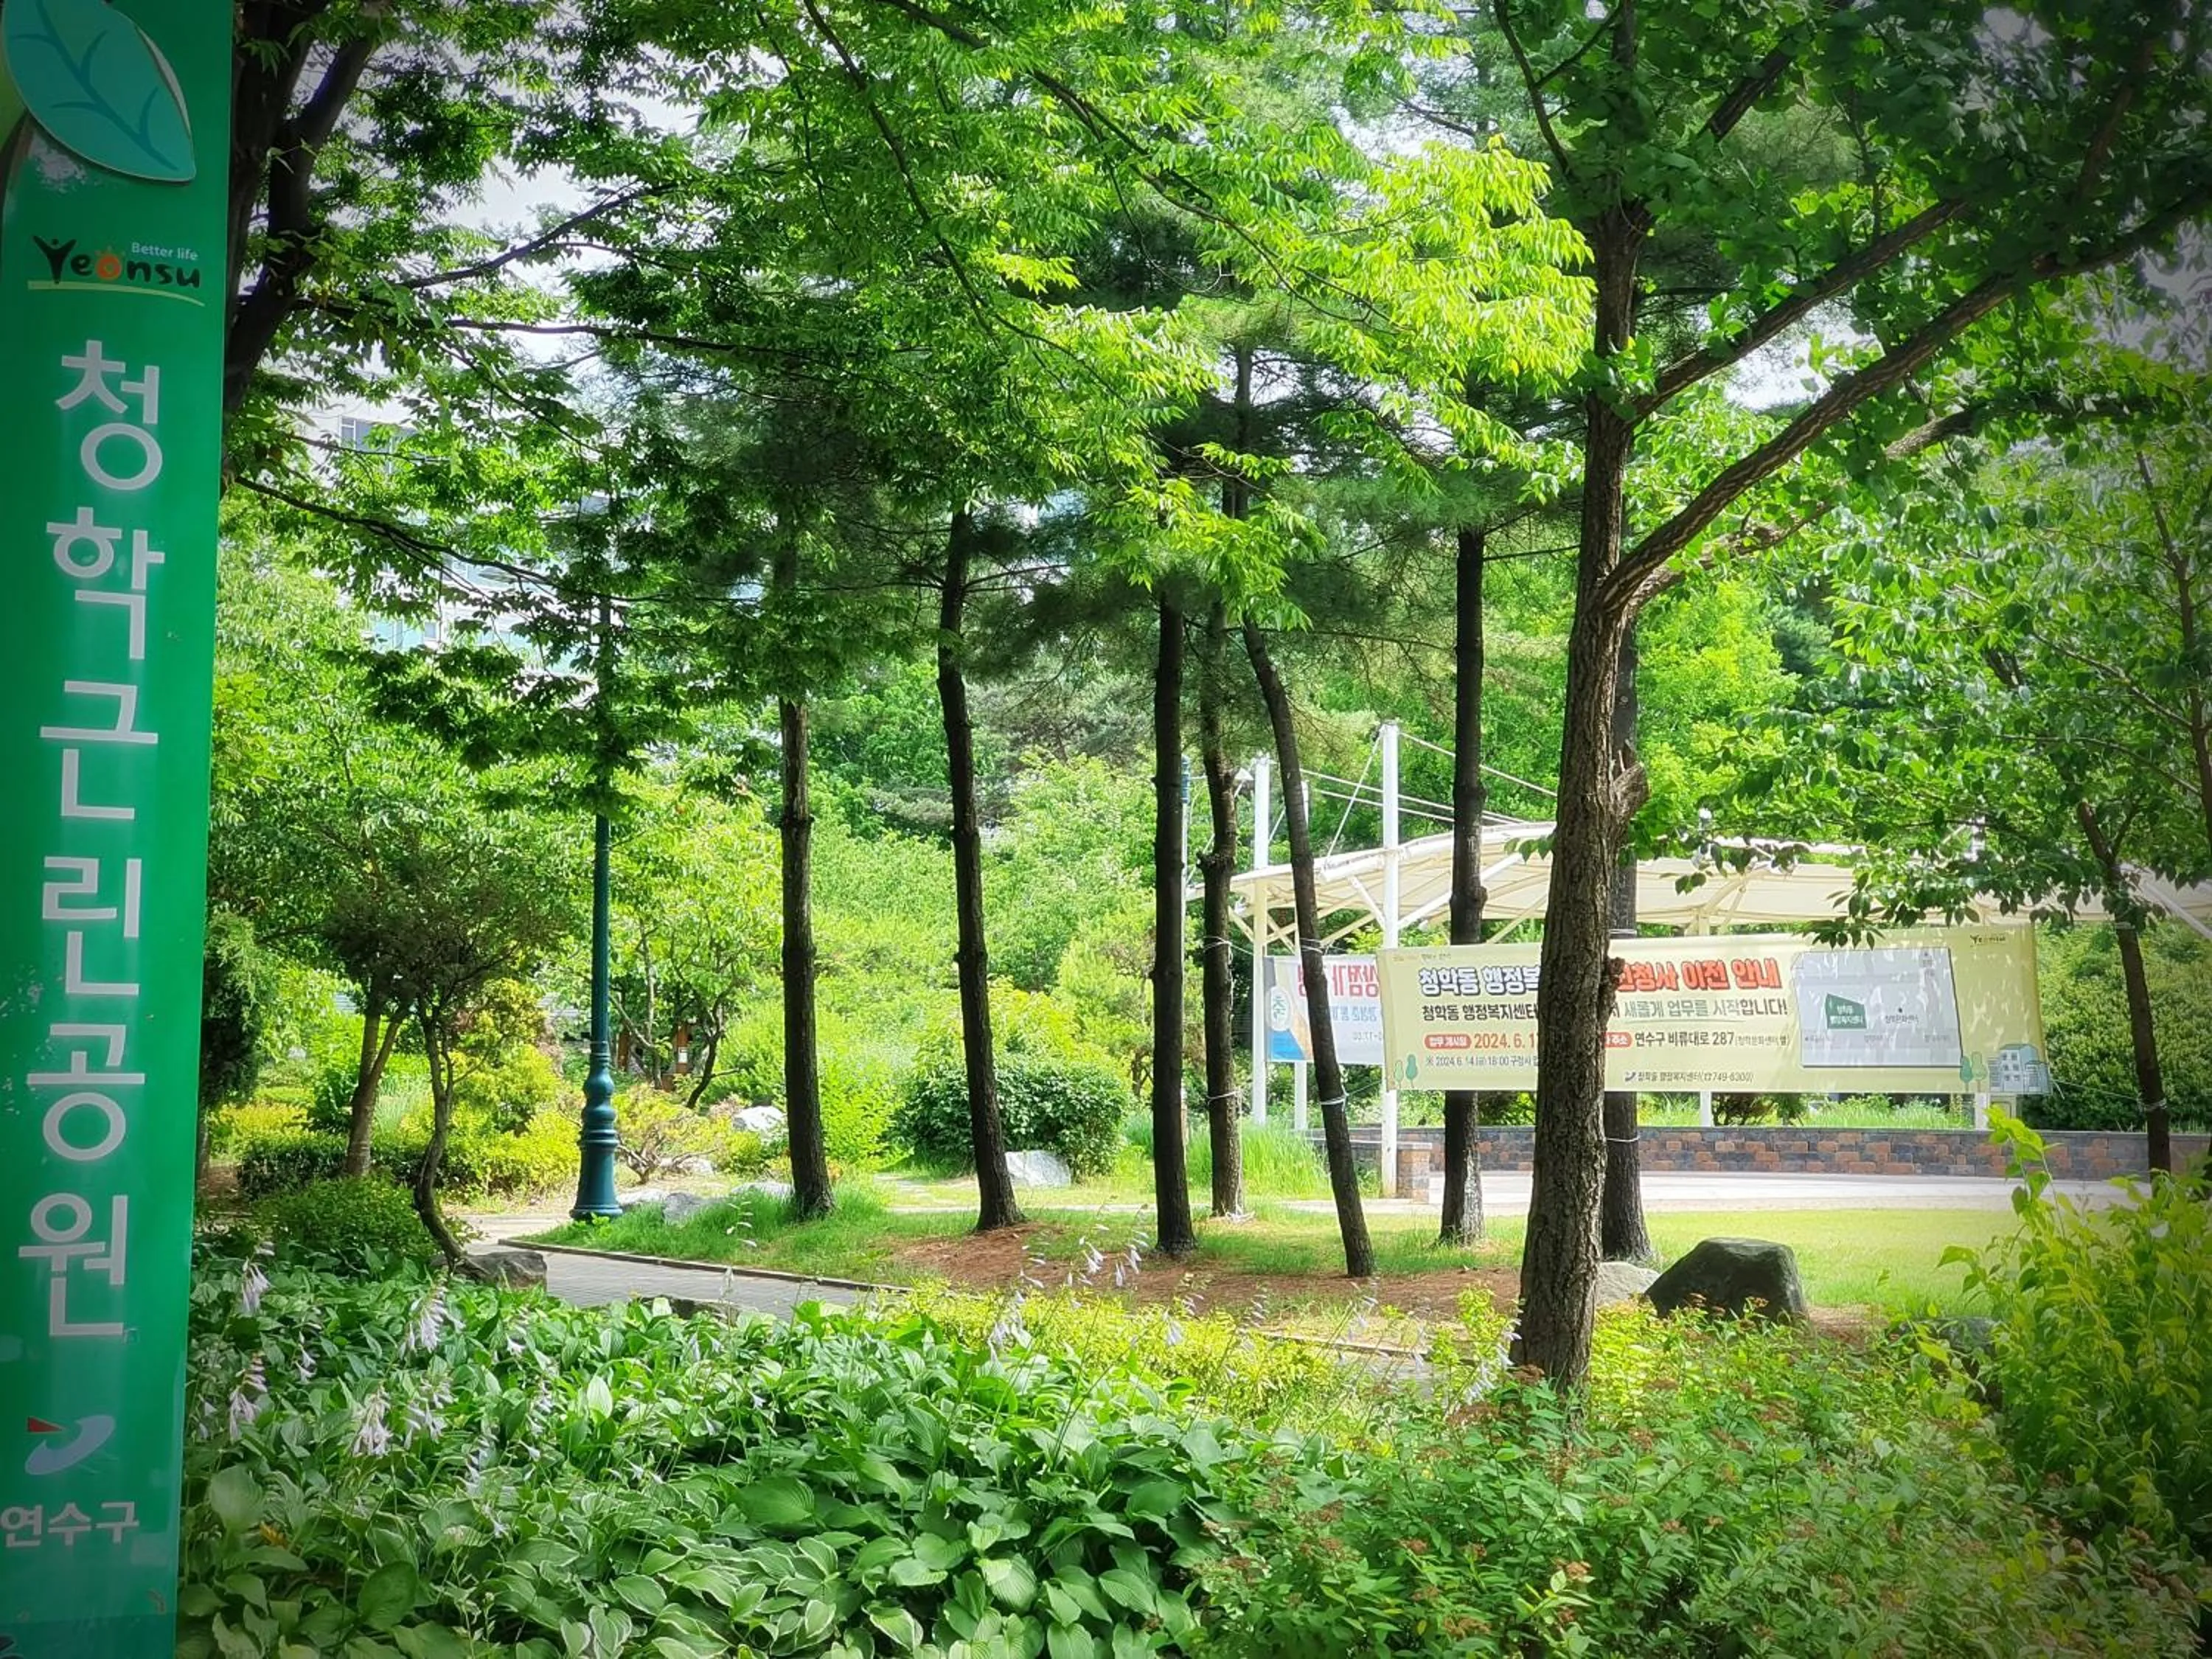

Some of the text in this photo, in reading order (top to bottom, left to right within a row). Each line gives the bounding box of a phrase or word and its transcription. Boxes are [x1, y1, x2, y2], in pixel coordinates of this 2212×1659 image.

[32, 234, 201, 288] Yeonsu
[131, 241, 199, 261] Better life
[18, 338, 165, 1337] 청학근린공원
[1419, 966, 1481, 997] 청학동
[1481, 964, 1540, 997] 행정복
[1681, 959, 1731, 991] 이전
[1731, 957, 1783, 990] 안내
[1422, 1004, 1459, 1021] 청학동
[1624, 999, 1664, 1018] 새롭게
[1667, 998, 1709, 1018] 업무를
[1713, 997, 1789, 1018] 시작합니다!
[1635, 1032, 1665, 1048] 연수구
[1668, 1032, 1711, 1047] 비류대로
[1712, 1032, 1734, 1046] 287
[0, 1501, 140, 1548] 연수구
